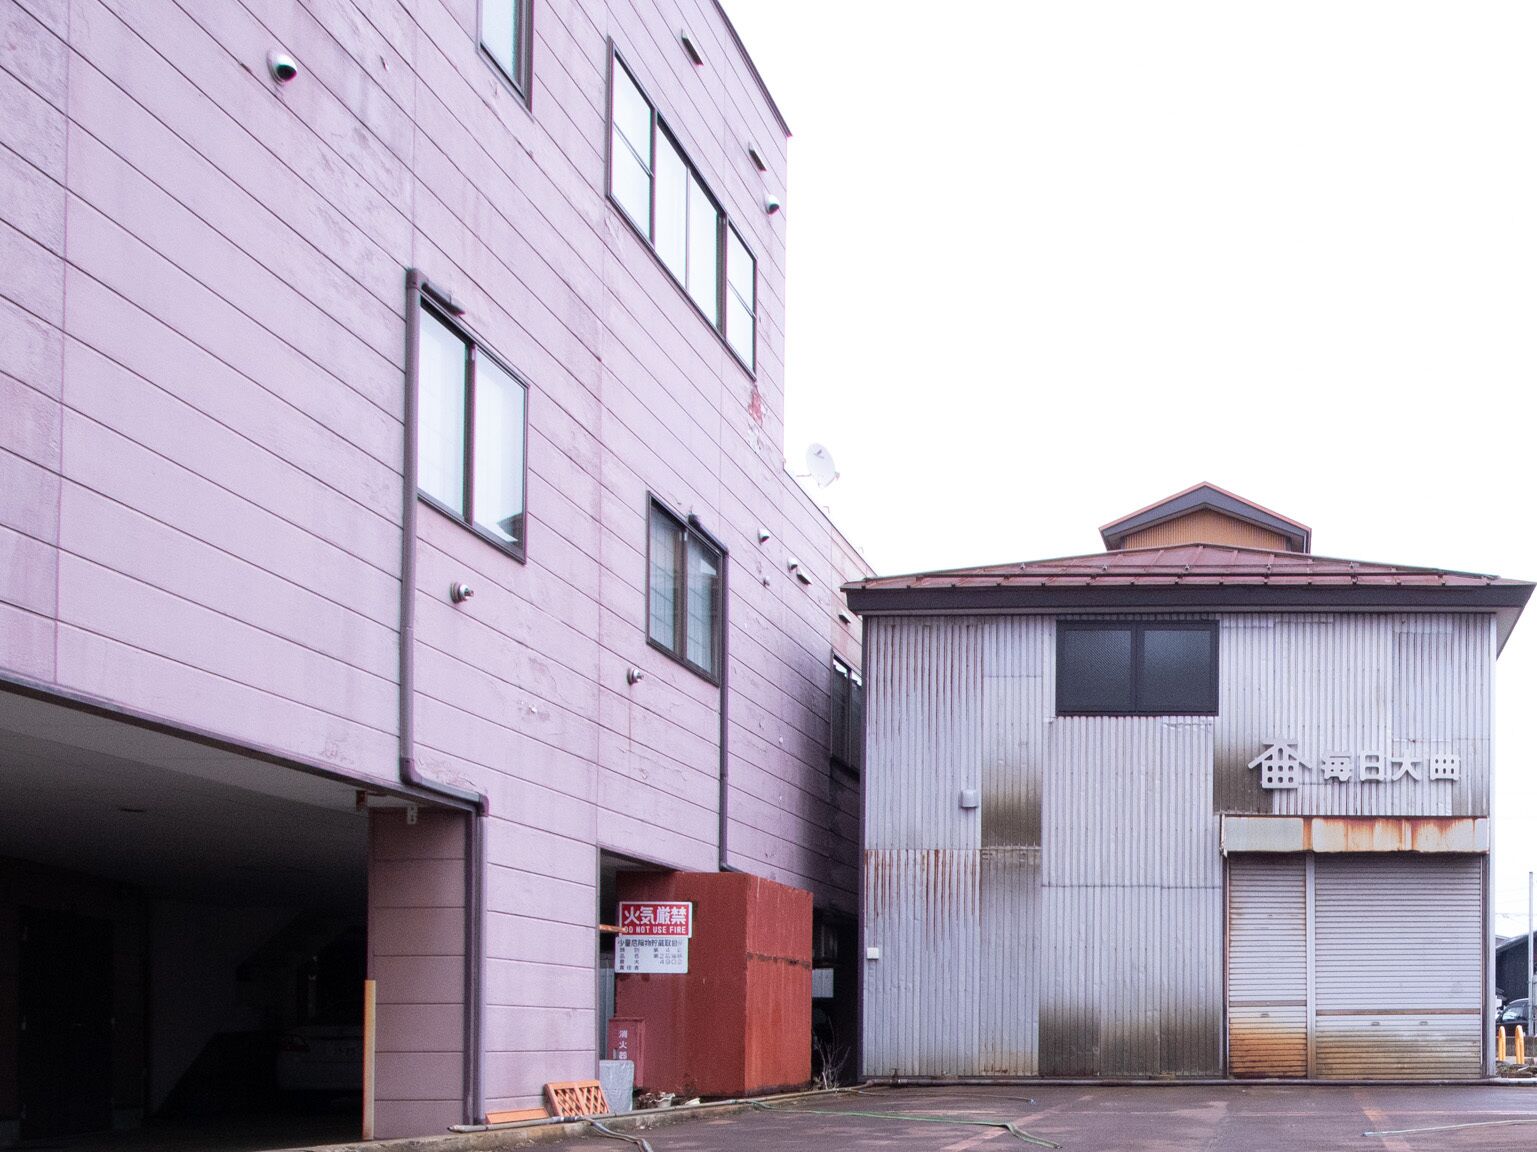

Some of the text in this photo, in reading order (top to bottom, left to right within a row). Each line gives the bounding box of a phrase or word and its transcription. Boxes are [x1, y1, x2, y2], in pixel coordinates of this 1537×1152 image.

[1321, 751, 1462, 783] 毎日大曲
[624, 906, 687, 925] 火気厳禁
[636, 926, 650, 934] NOT
[653, 926, 667, 934] USE
[669, 926, 686, 934] FIRE
